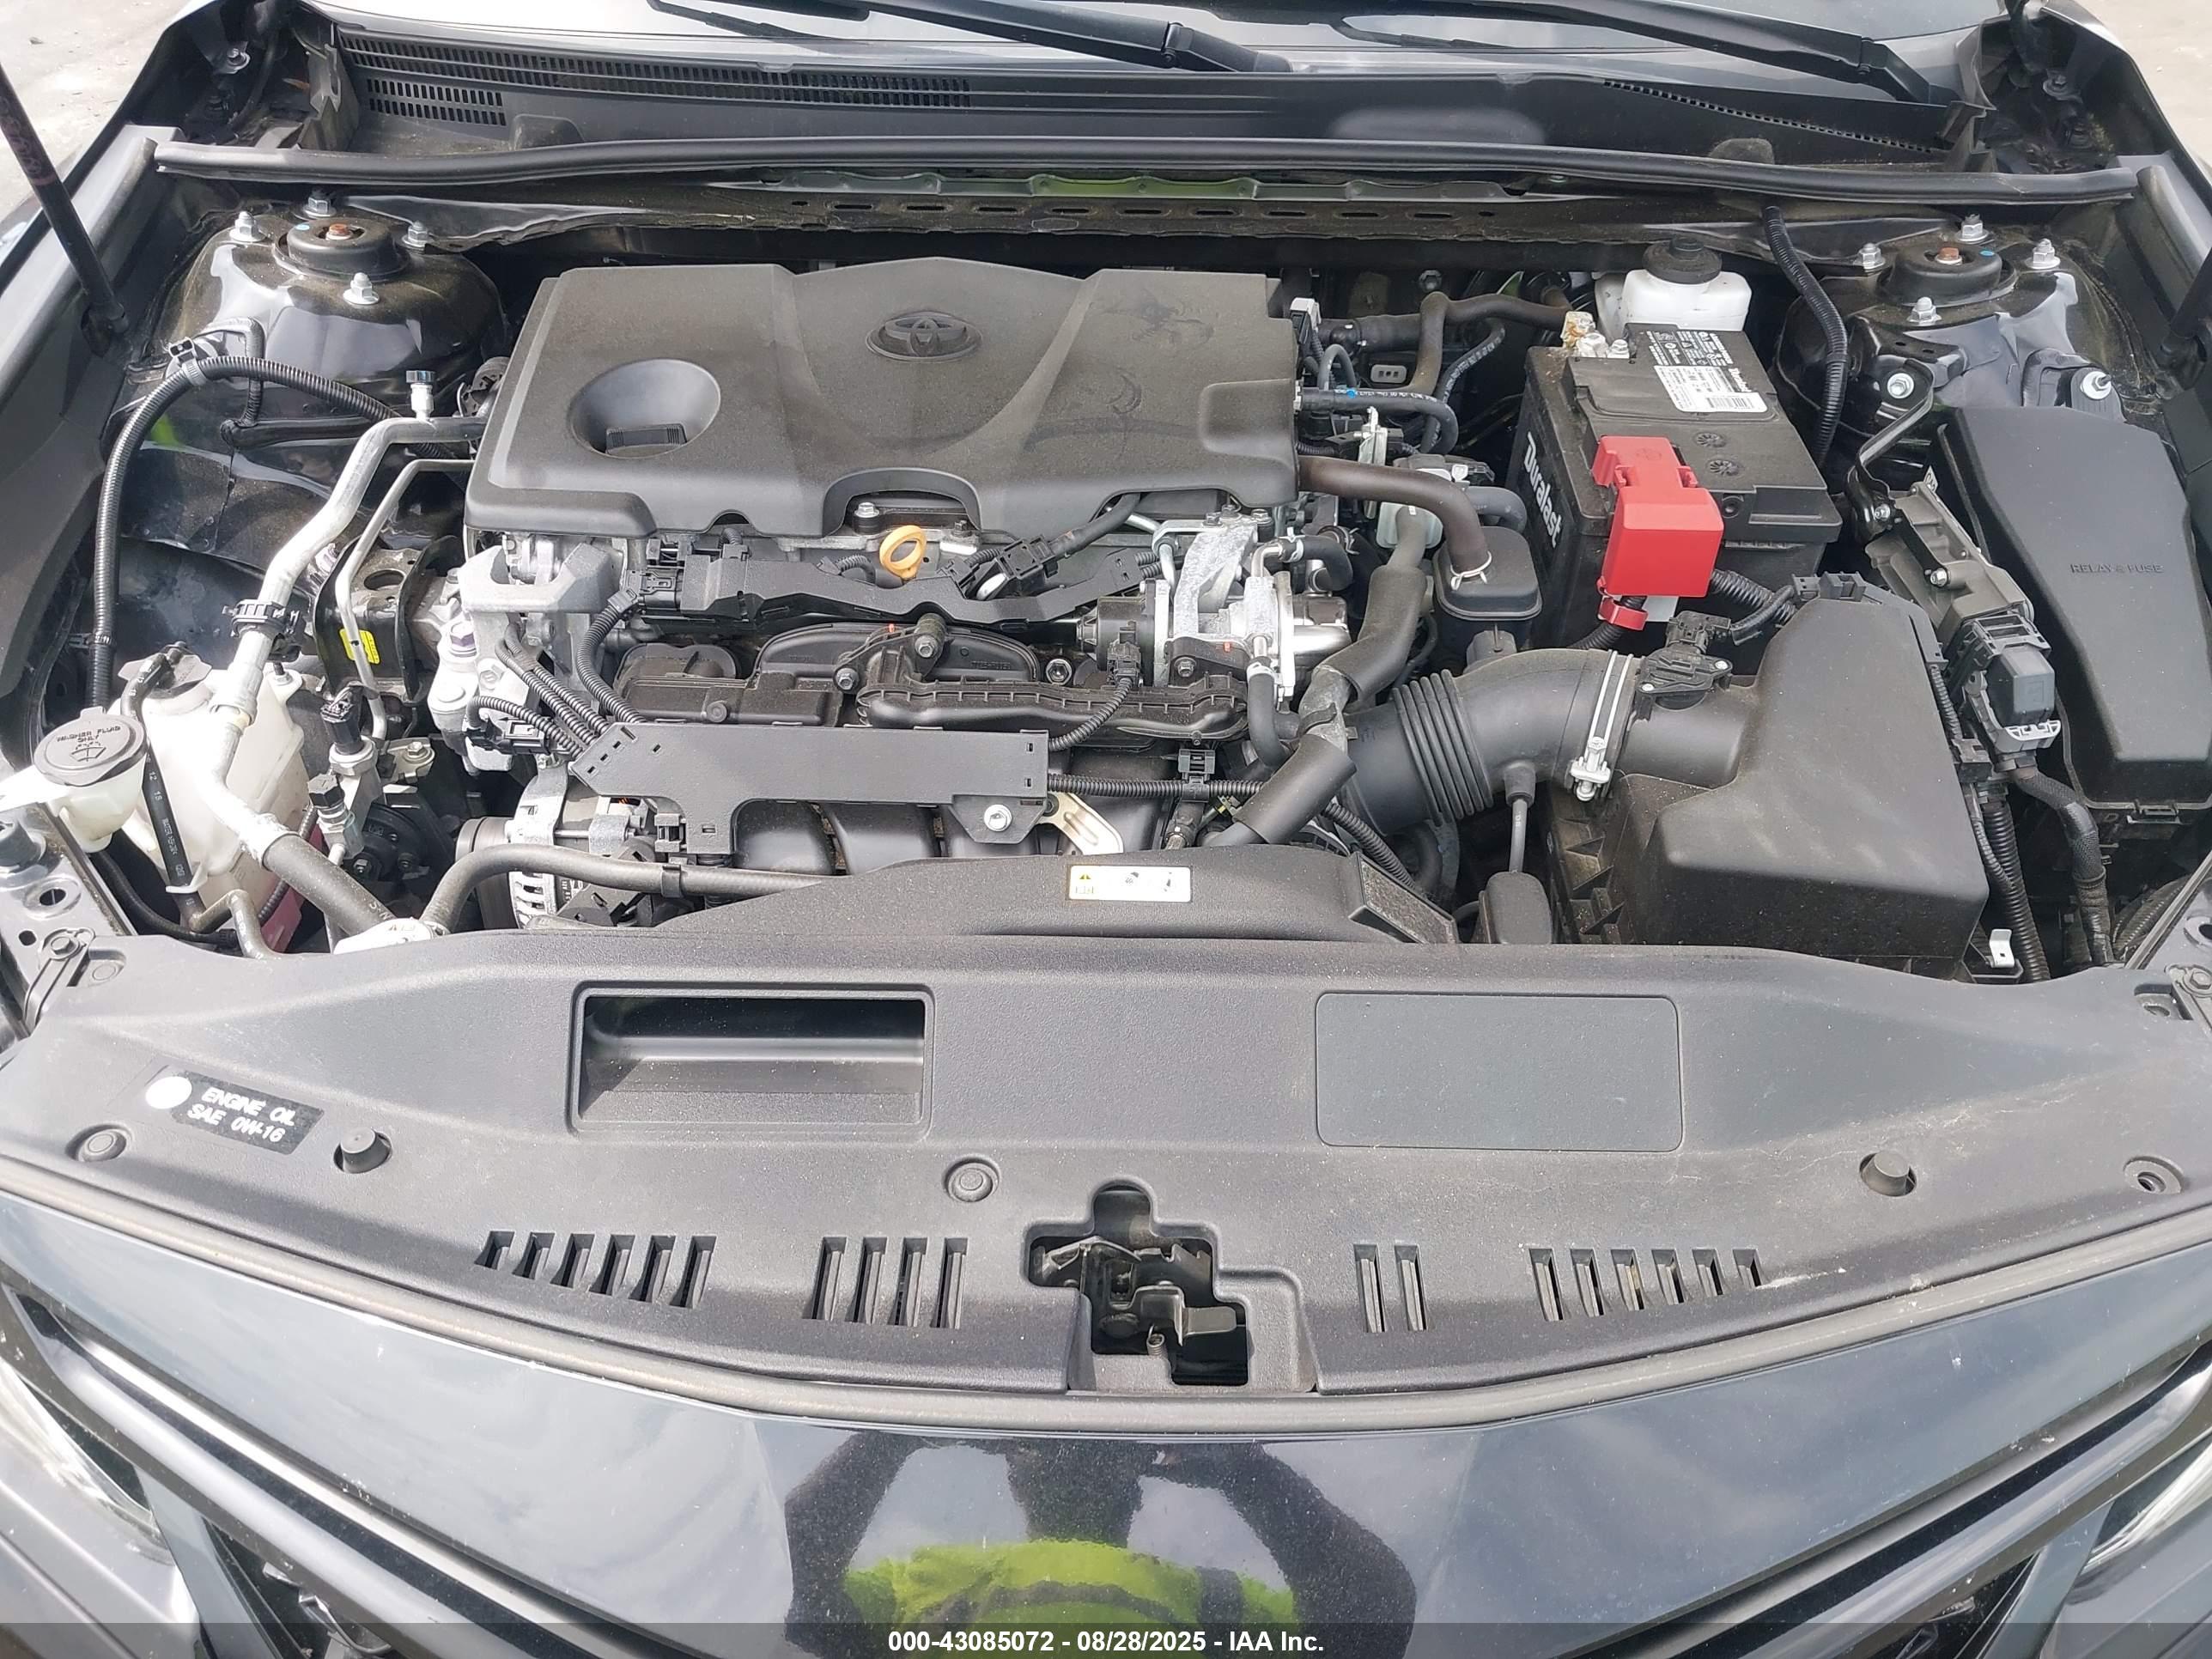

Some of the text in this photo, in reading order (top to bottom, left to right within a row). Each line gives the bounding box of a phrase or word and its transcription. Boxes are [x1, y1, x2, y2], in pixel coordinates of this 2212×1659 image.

[1524, 431, 1562, 549] Duralast
[2069, 563, 2112, 574] RELAY
[2127, 563, 2164, 574] FUSE
[186, 1103, 287, 1144] SAE 0W-16
[201, 1086, 296, 1127] ENGINE OIL
